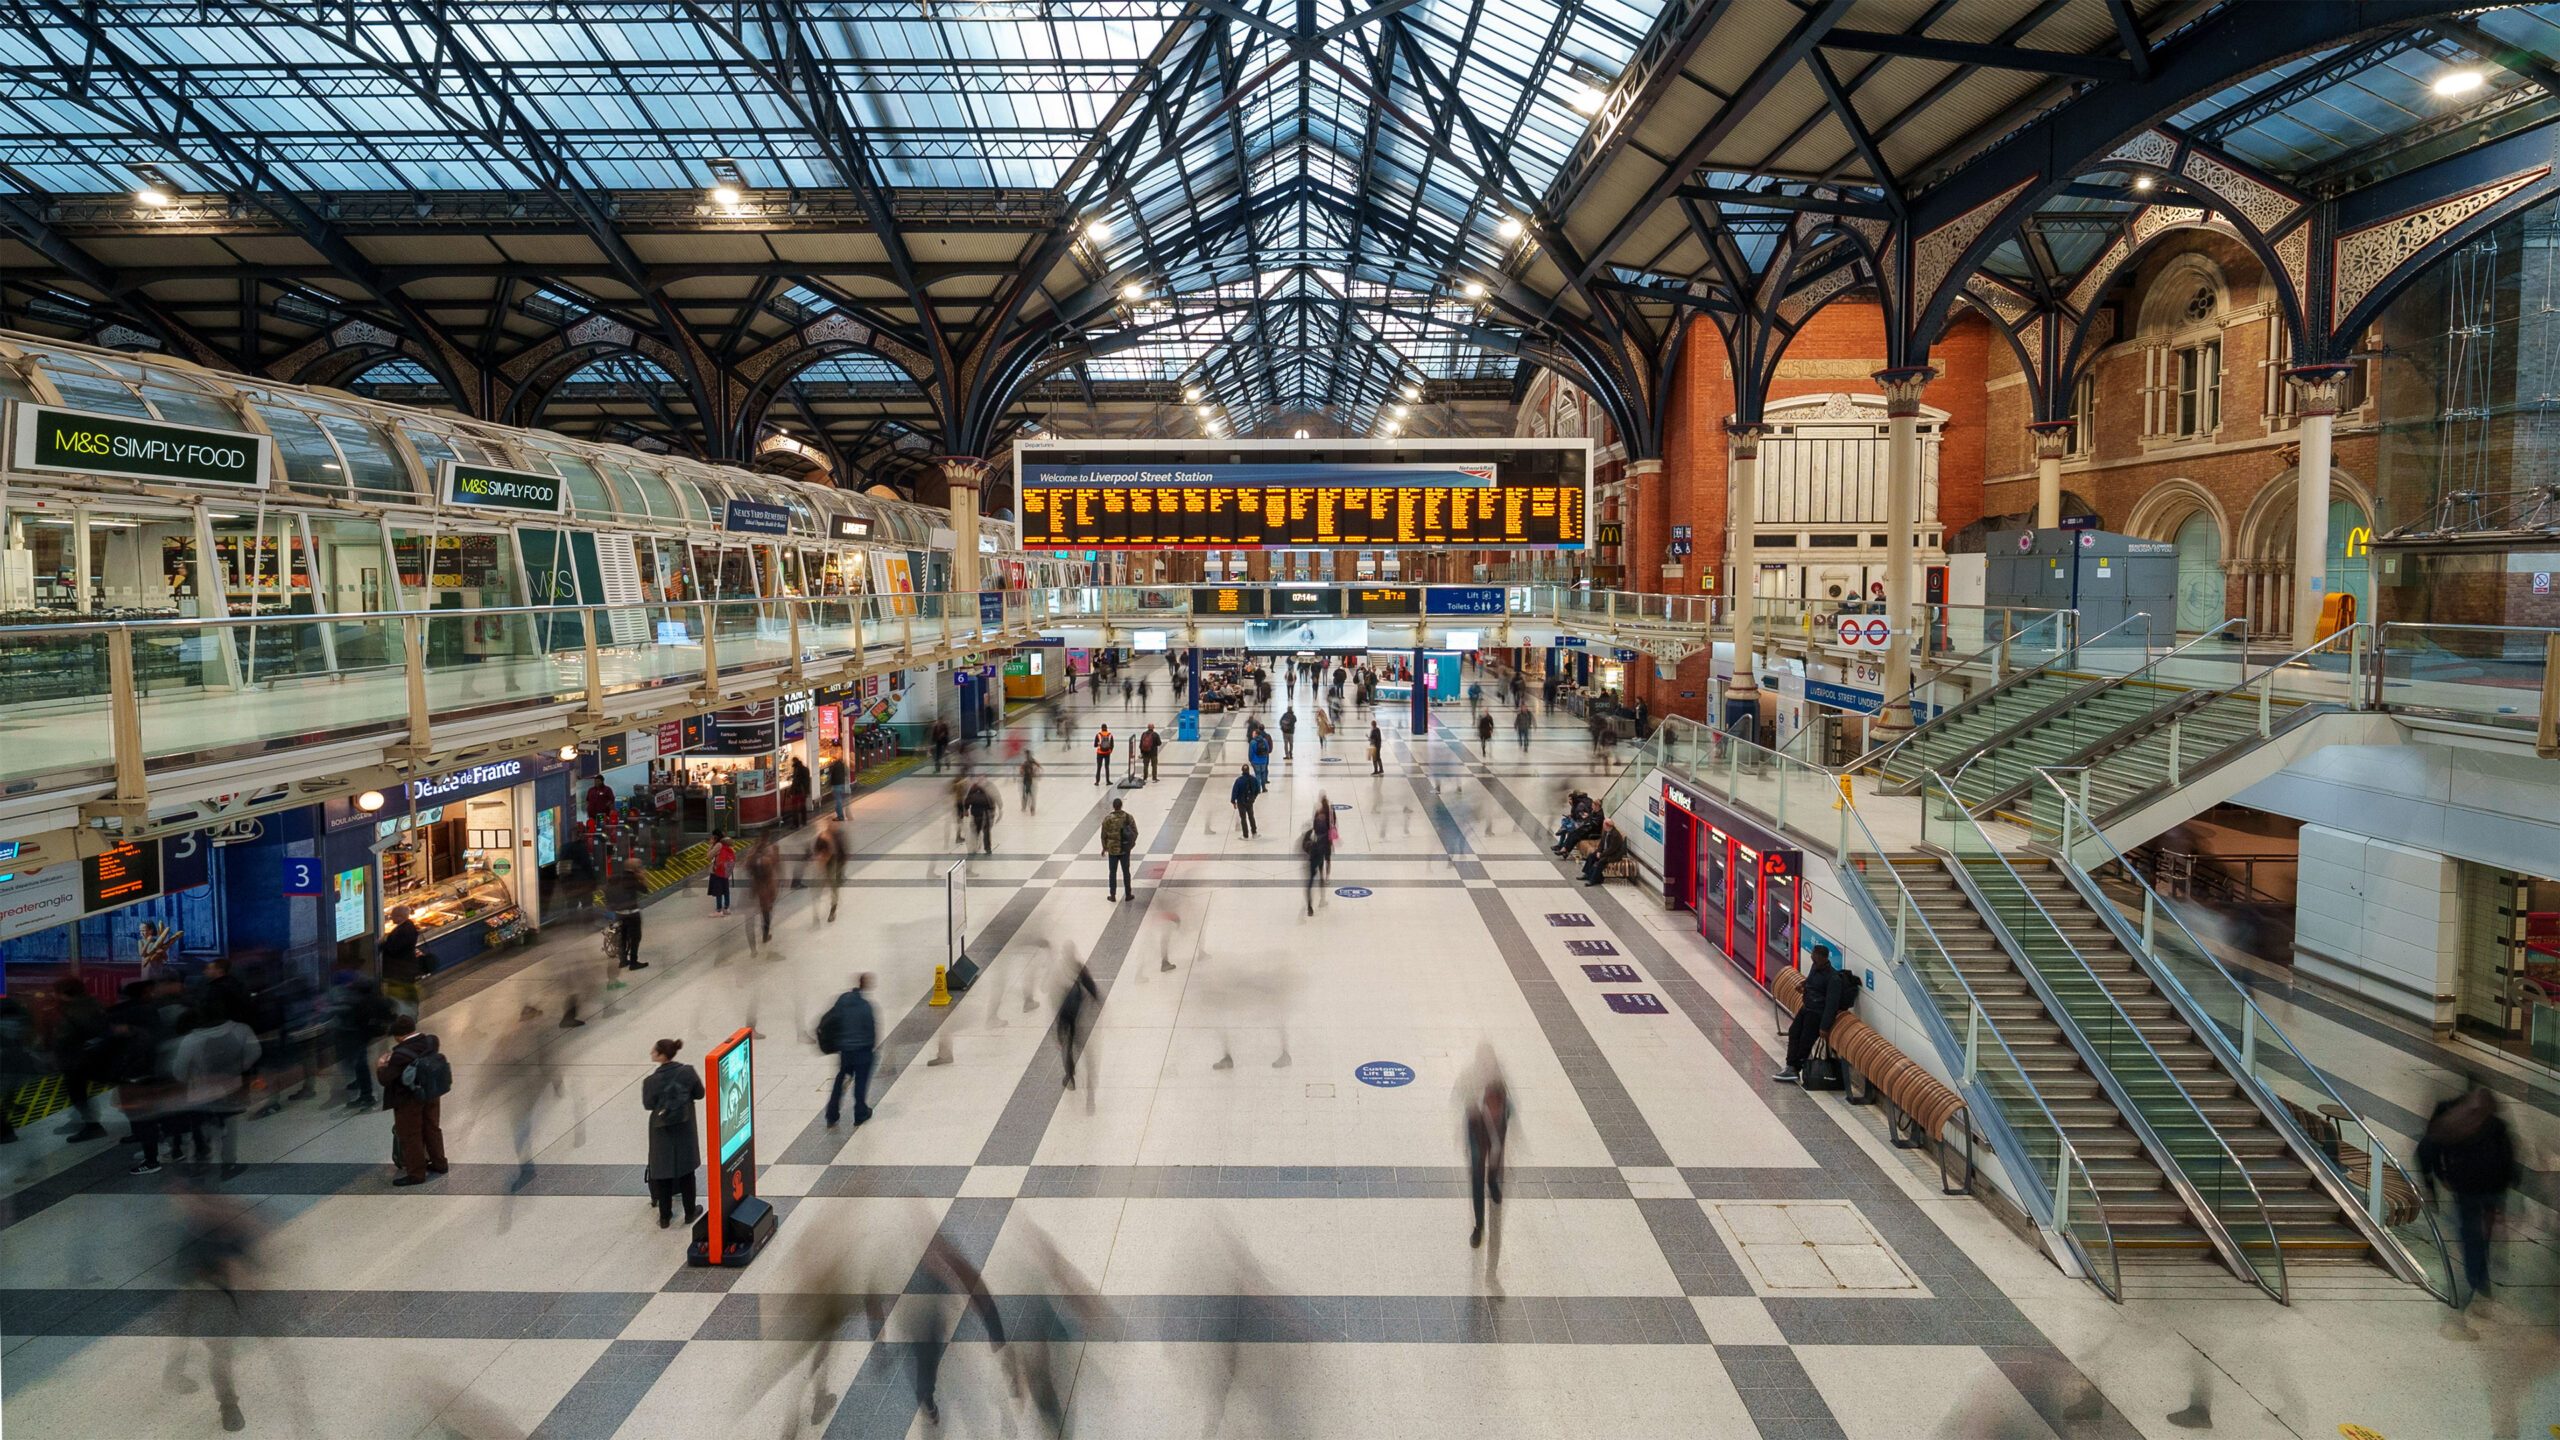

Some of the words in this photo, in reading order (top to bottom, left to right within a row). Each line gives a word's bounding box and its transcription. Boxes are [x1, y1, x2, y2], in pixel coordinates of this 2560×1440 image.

[56, 429, 110, 455] M&S
[113, 436, 185, 463] SIMPLY
[188, 445, 245, 469] FOOD
[461, 478, 488, 495] M&S
[488, 481, 524, 498] SIMPLY
[524, 485, 553, 501] FOOD
[1040, 473, 1078, 482] Welcome
[1079, 474, 1088, 482] to
[1090, 472, 1138, 484] Liverpool
[1140, 472, 1172, 482] Street
[1174, 472, 1213, 482] Station
[751, 509, 764, 519] YARD
[764, 511, 787, 521] REMEDIES
[526, 570, 575, 598] M&S
[1447, 602, 1470, 610] Toilets
[958, 674, 964, 682] 6
[1810, 688, 1836, 699] LIVERPOOL
[1838, 694, 1856, 703] STREET
[460, 773, 472, 785] de
[473, 761, 520, 785] France
[1669, 786, 1691, 811] NatWest
[174, 831, 197, 859] 3
[294, 864, 310, 888] 3
